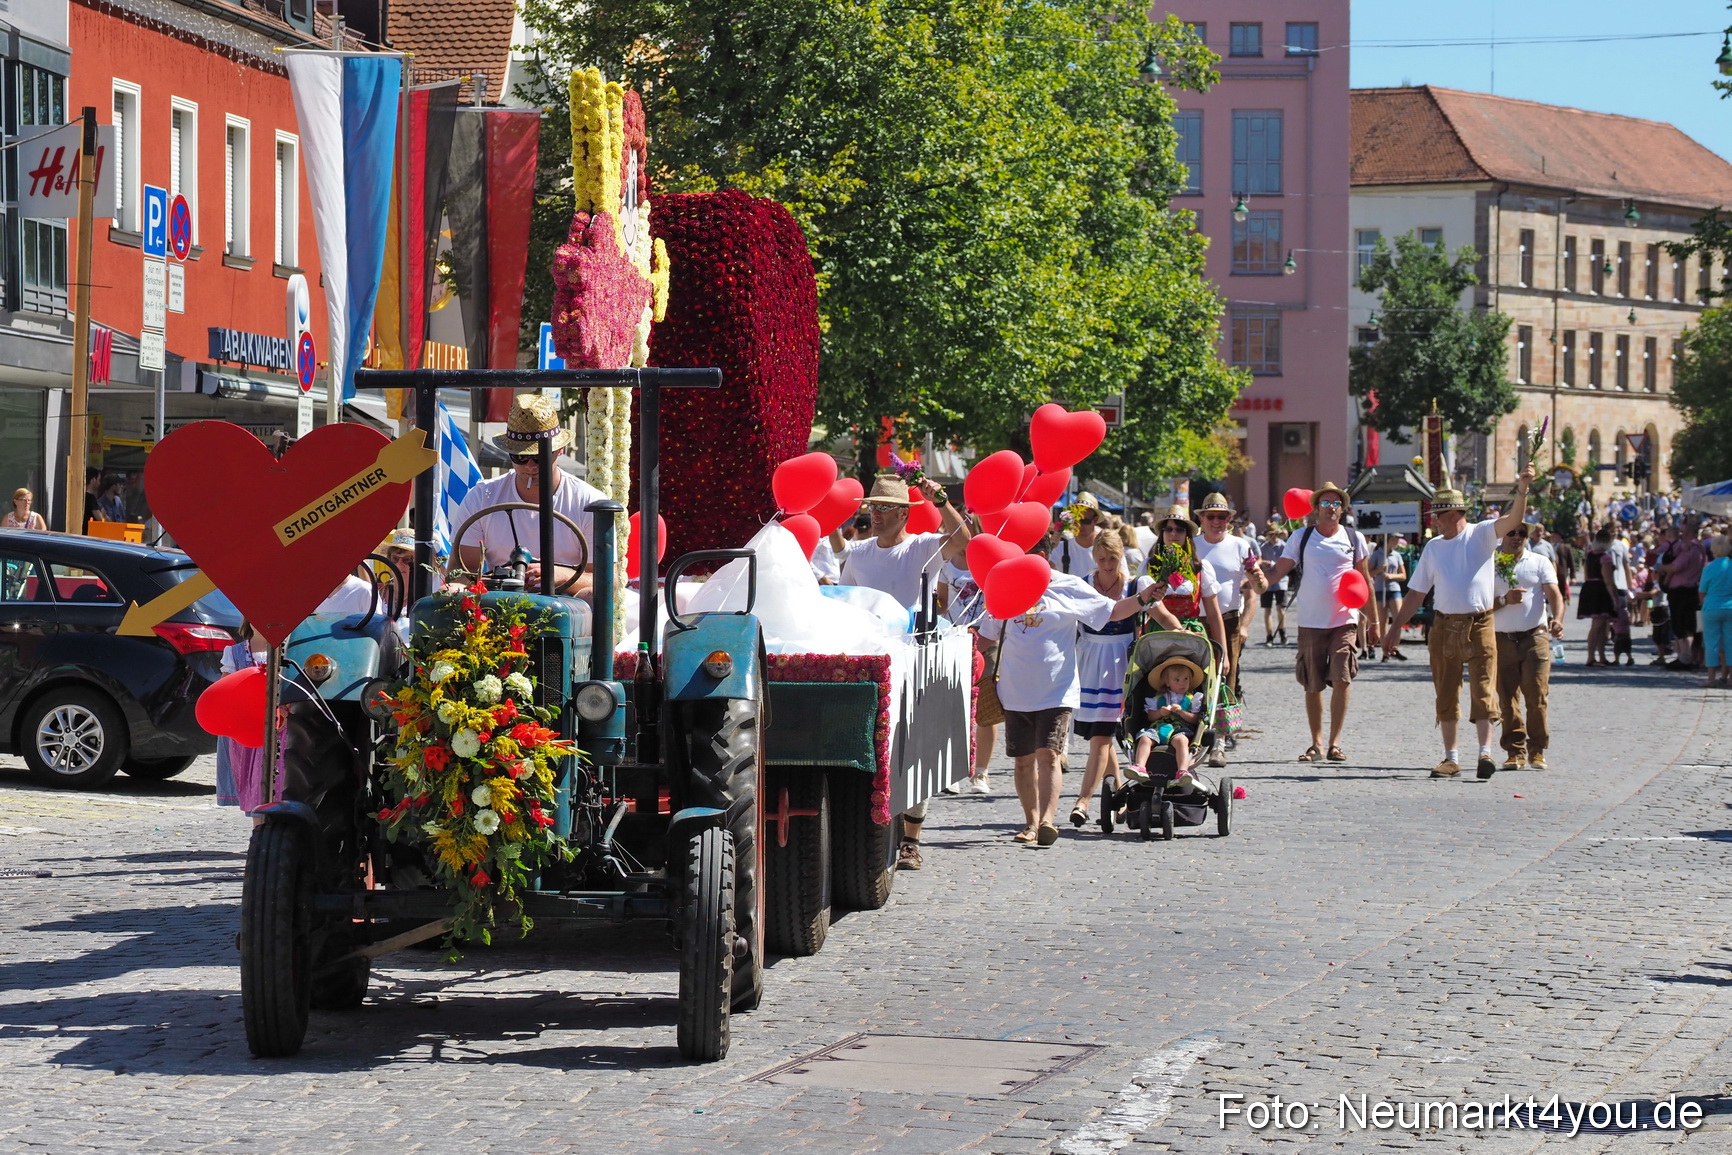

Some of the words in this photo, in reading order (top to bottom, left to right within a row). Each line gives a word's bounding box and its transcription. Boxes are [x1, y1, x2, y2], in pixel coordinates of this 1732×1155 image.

[28, 145, 105, 198] H&M
[148, 195, 162, 246] P
[284, 468, 388, 538] STADTGÄRTNER
